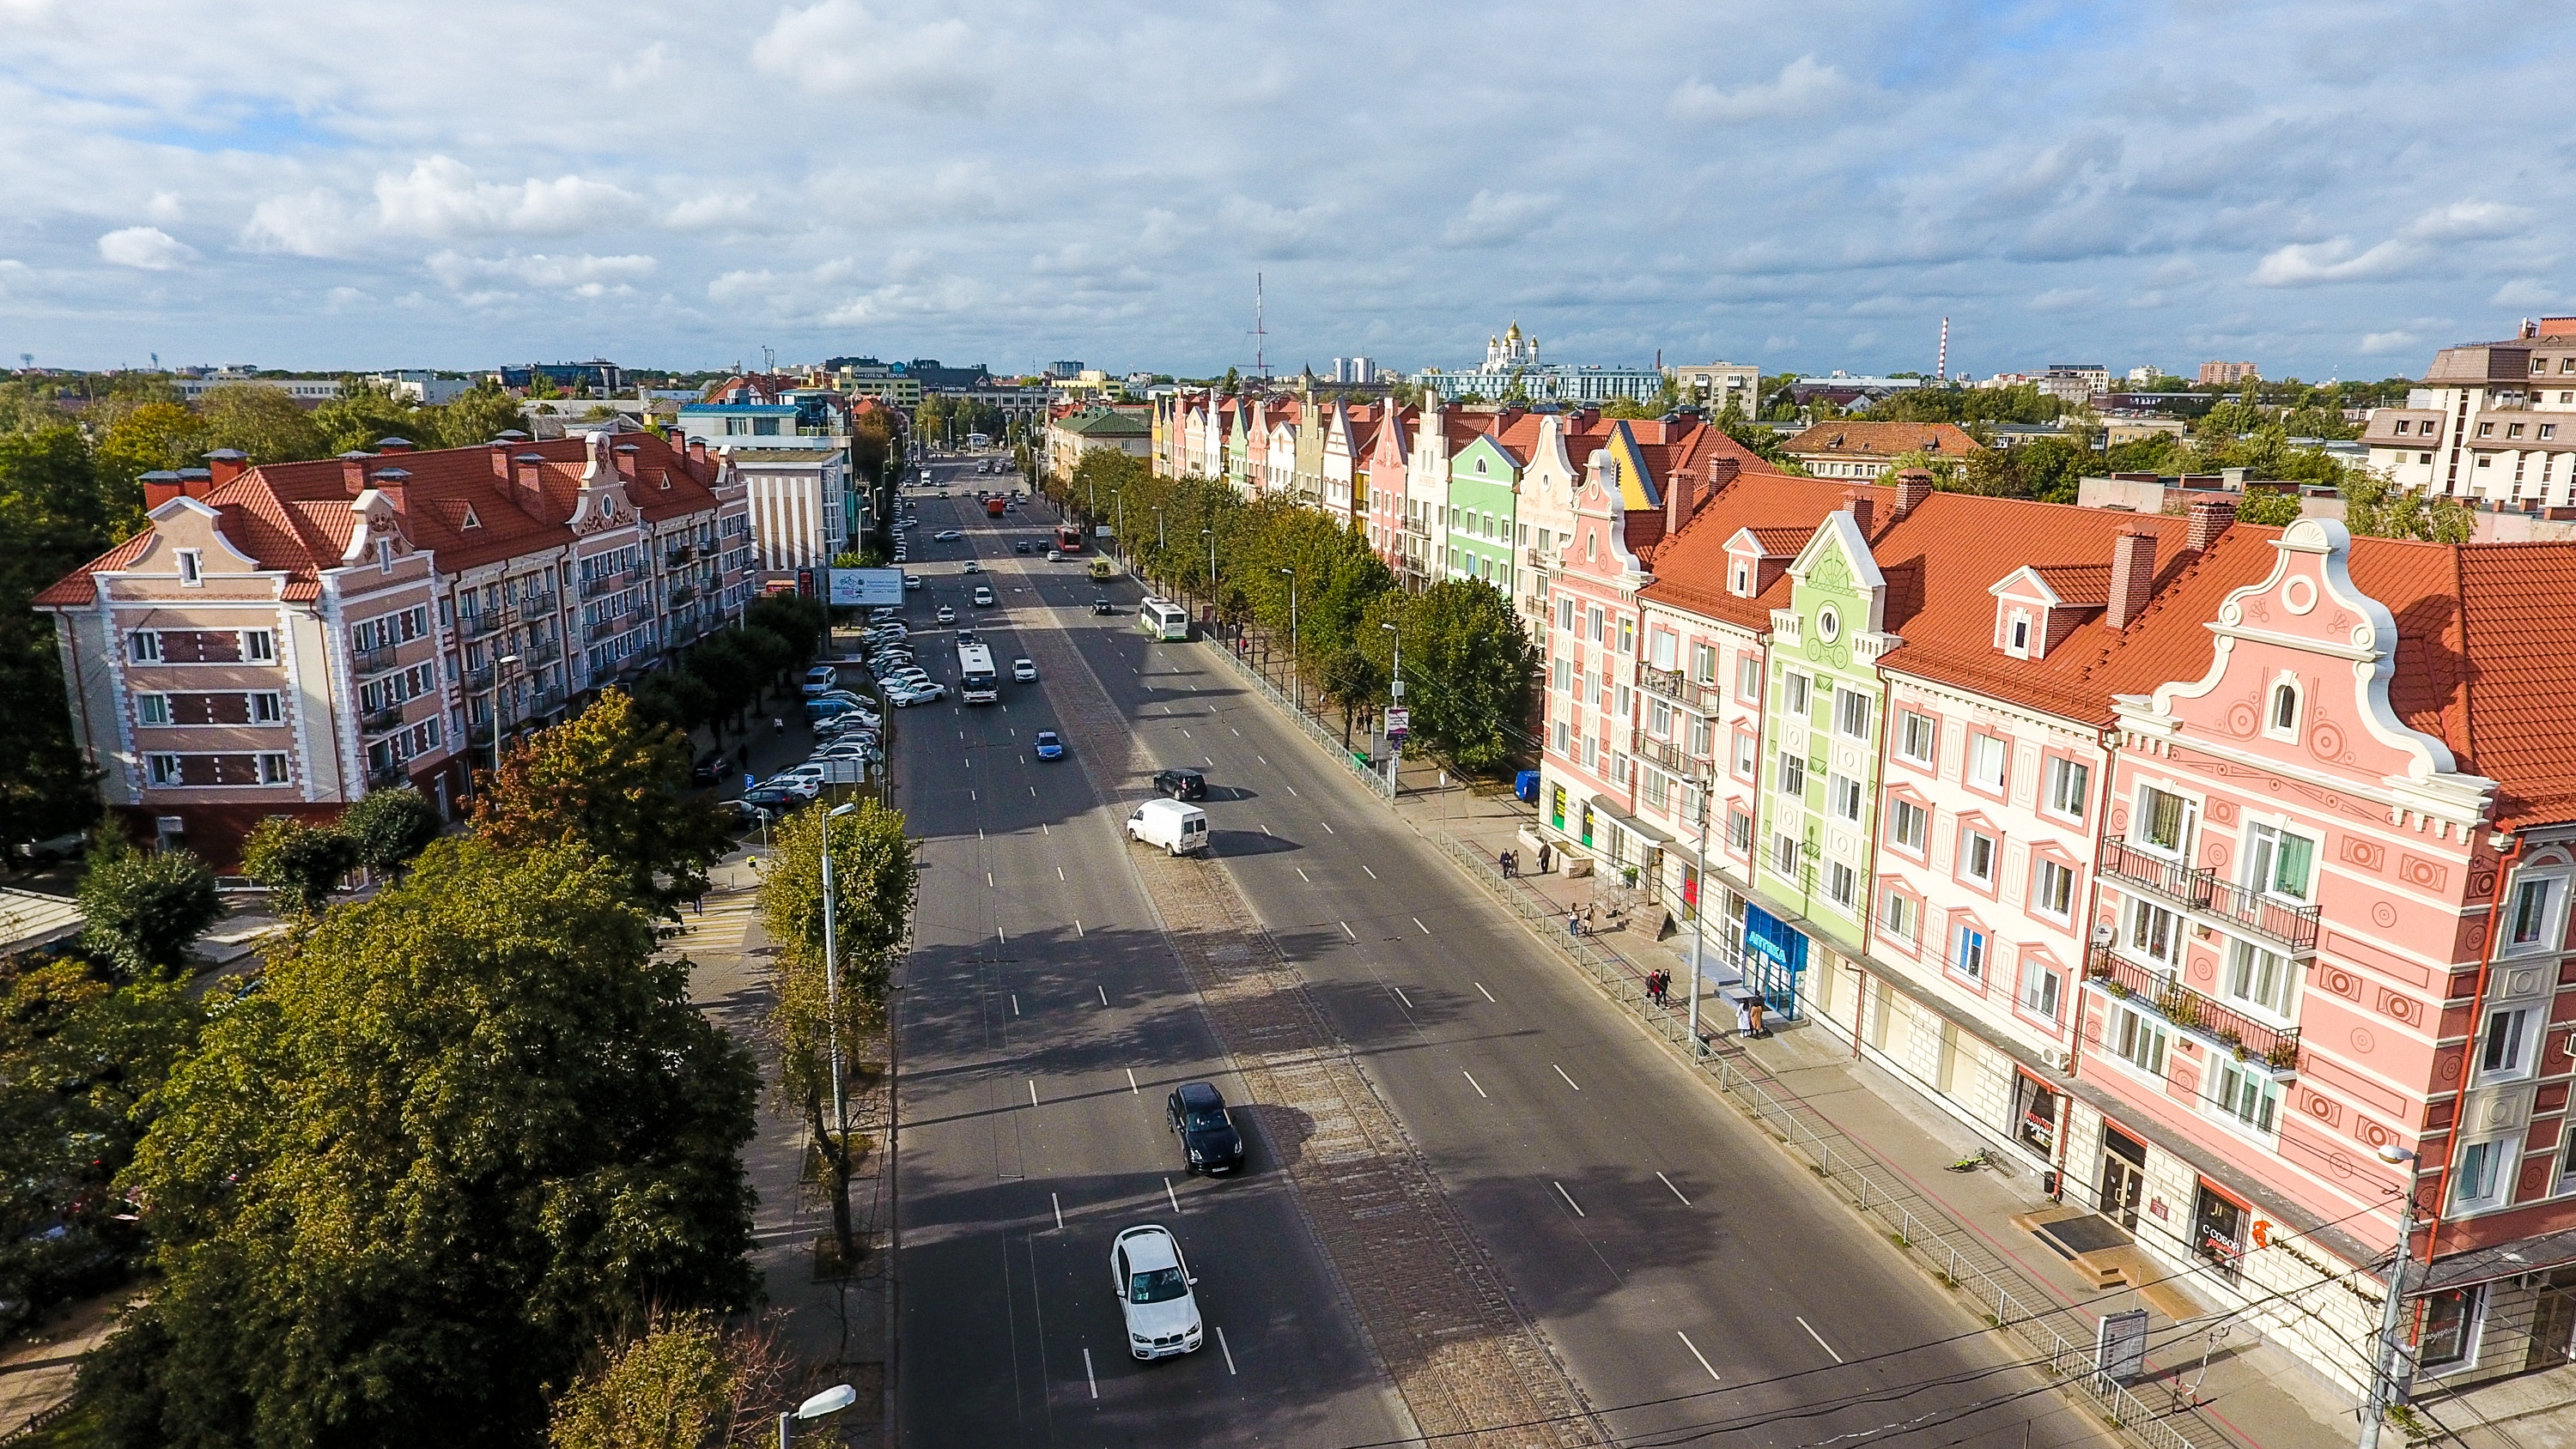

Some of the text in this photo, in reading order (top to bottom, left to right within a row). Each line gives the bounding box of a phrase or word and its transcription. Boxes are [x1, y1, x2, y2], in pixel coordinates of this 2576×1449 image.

[1748, 931, 1787, 963] АПТЕКА
[2024, 1109, 2053, 1131] ПОЛУЧИ
[2202, 1224, 2240, 1254] С СОБОЙ
